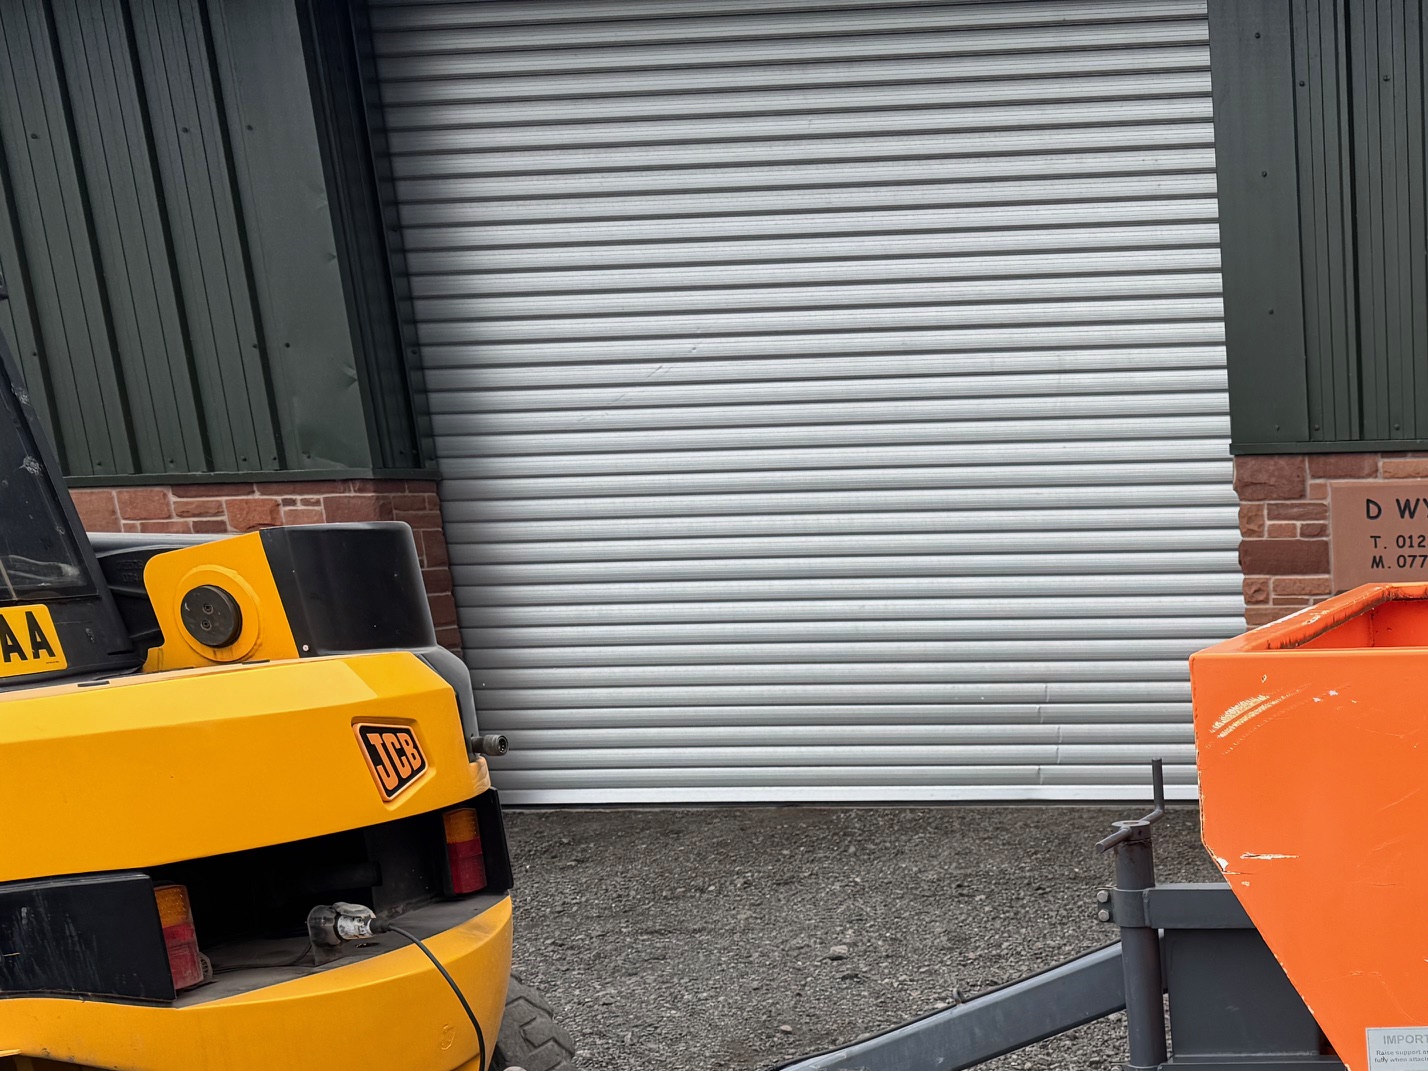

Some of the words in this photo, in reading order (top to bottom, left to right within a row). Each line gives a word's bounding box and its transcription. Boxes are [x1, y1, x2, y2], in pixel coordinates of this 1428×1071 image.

[1366, 498, 1382, 520] D
[1370, 535, 1387, 549] T.
[1371, 554, 1391, 569] M.
[366, 732, 422, 790] JCB
